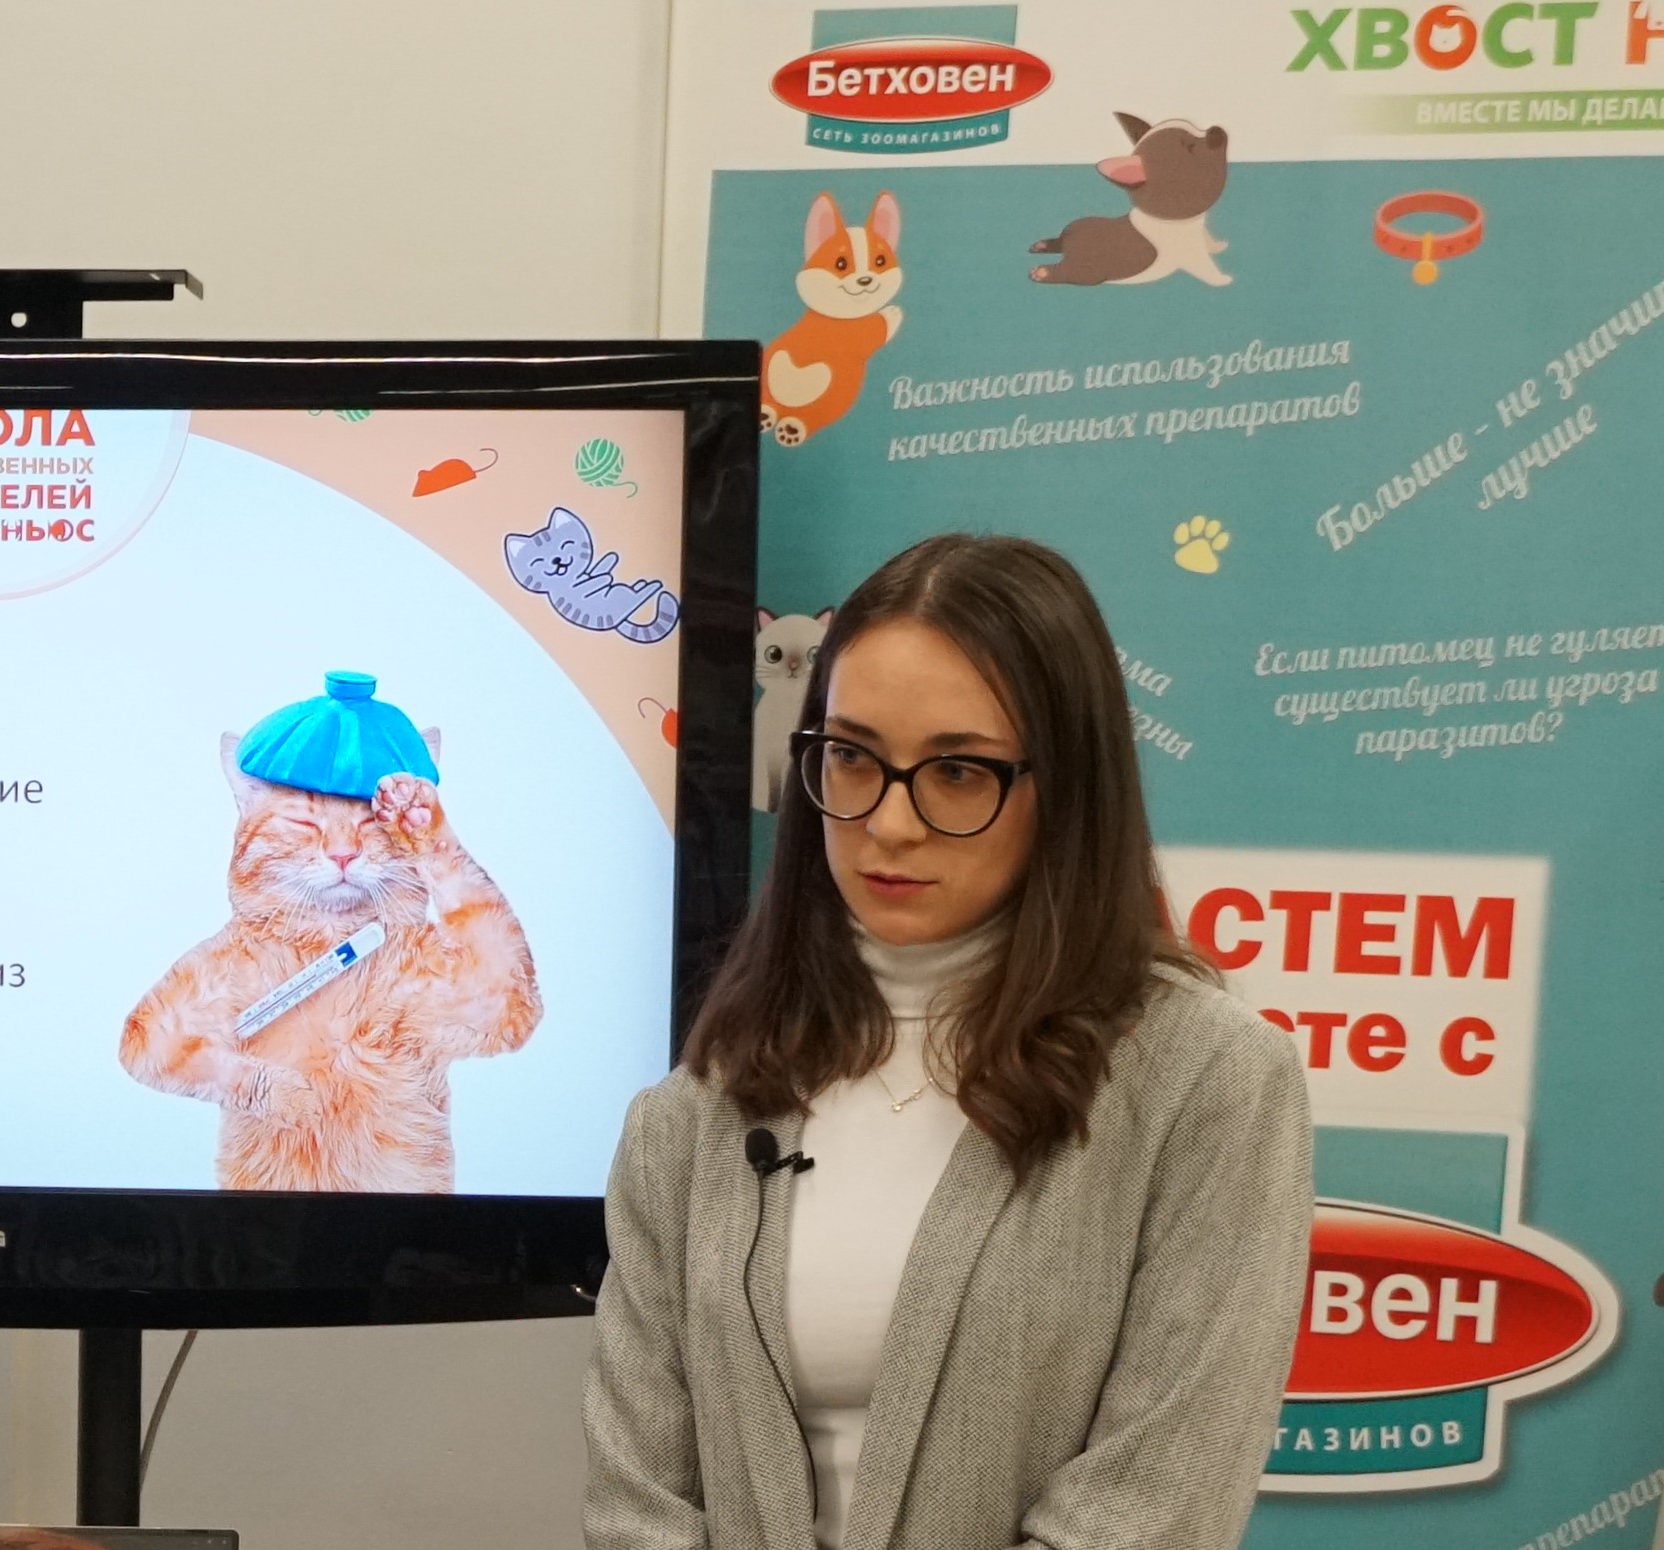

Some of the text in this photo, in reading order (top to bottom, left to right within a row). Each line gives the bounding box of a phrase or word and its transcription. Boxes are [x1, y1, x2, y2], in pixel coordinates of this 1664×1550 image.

[1285, 2, 1599, 73] ХВОСТ
[806, 59, 1016, 98] Бетховен
[812, 123, 1002, 146] СЕТЬ ЗООМАГАЗИНОВ
[1415, 99, 1522, 126] ВМЕСТЕ
[1528, 97, 1574, 123] МЫ
[888, 338, 1351, 411] Важность использования
[887, 379, 1361, 463] качественных препаратов
[1315, 377, 1542, 552] Больше не
[1476, 403, 1599, 511] лучше
[0, 518, 96, 543] НЬЮС
[1254, 643, 1329, 677] Если
[1335, 635, 1495, 674] питомец
[1503, 632, 1543, 659] не
[1274, 667, 1659, 726] существует ли угроза
[1354, 711, 1564, 762] паразитов?
[1157, 886, 1516, 981] СТЕМ
[1439, 1016, 1497, 1078] с
